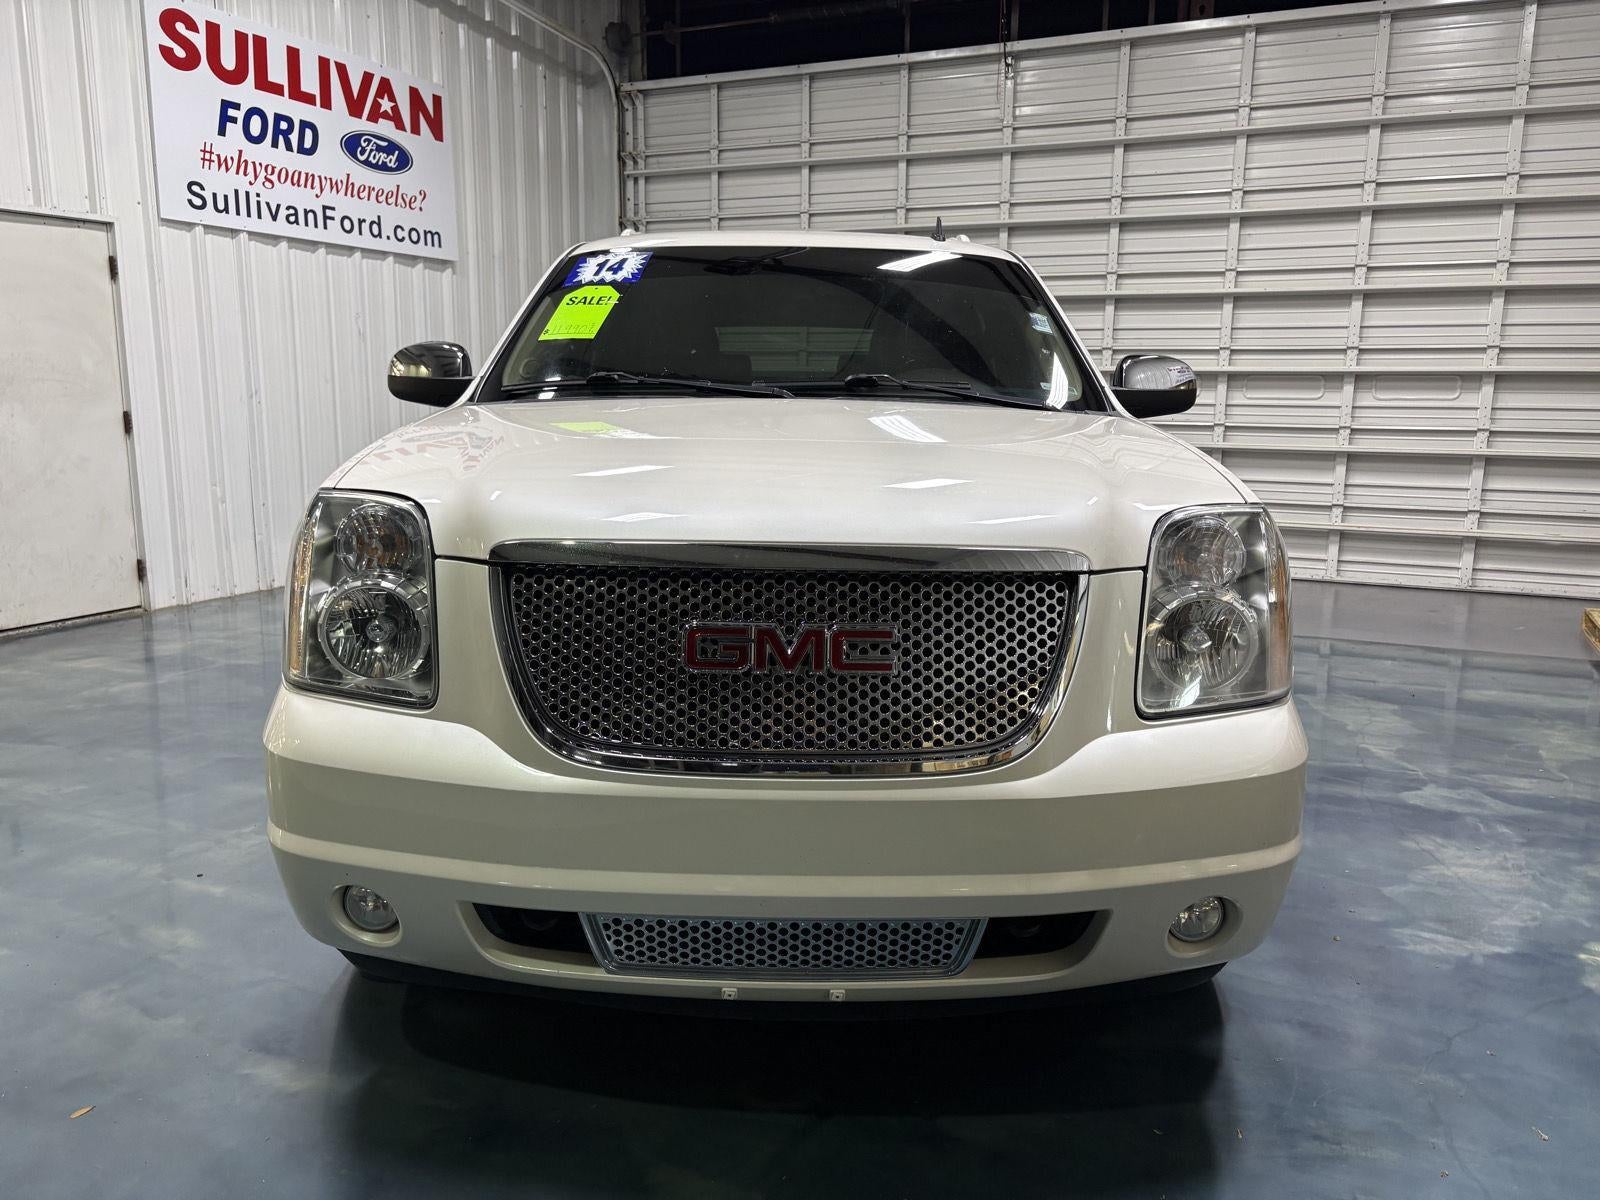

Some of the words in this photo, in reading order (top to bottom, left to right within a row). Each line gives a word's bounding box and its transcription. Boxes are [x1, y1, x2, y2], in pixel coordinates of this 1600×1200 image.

[159, 7, 444, 142] SULLIVAN
[217, 98, 320, 156] FORD
[356, 134, 400, 169] Ford
[200, 141, 427, 212] #whygoanywhereelse?
[186, 180, 443, 249] SullivanFord.com
[592, 257, 629, 277] 14
[566, 295, 613, 306] SALE!
[682, 621, 898, 675] GMC
